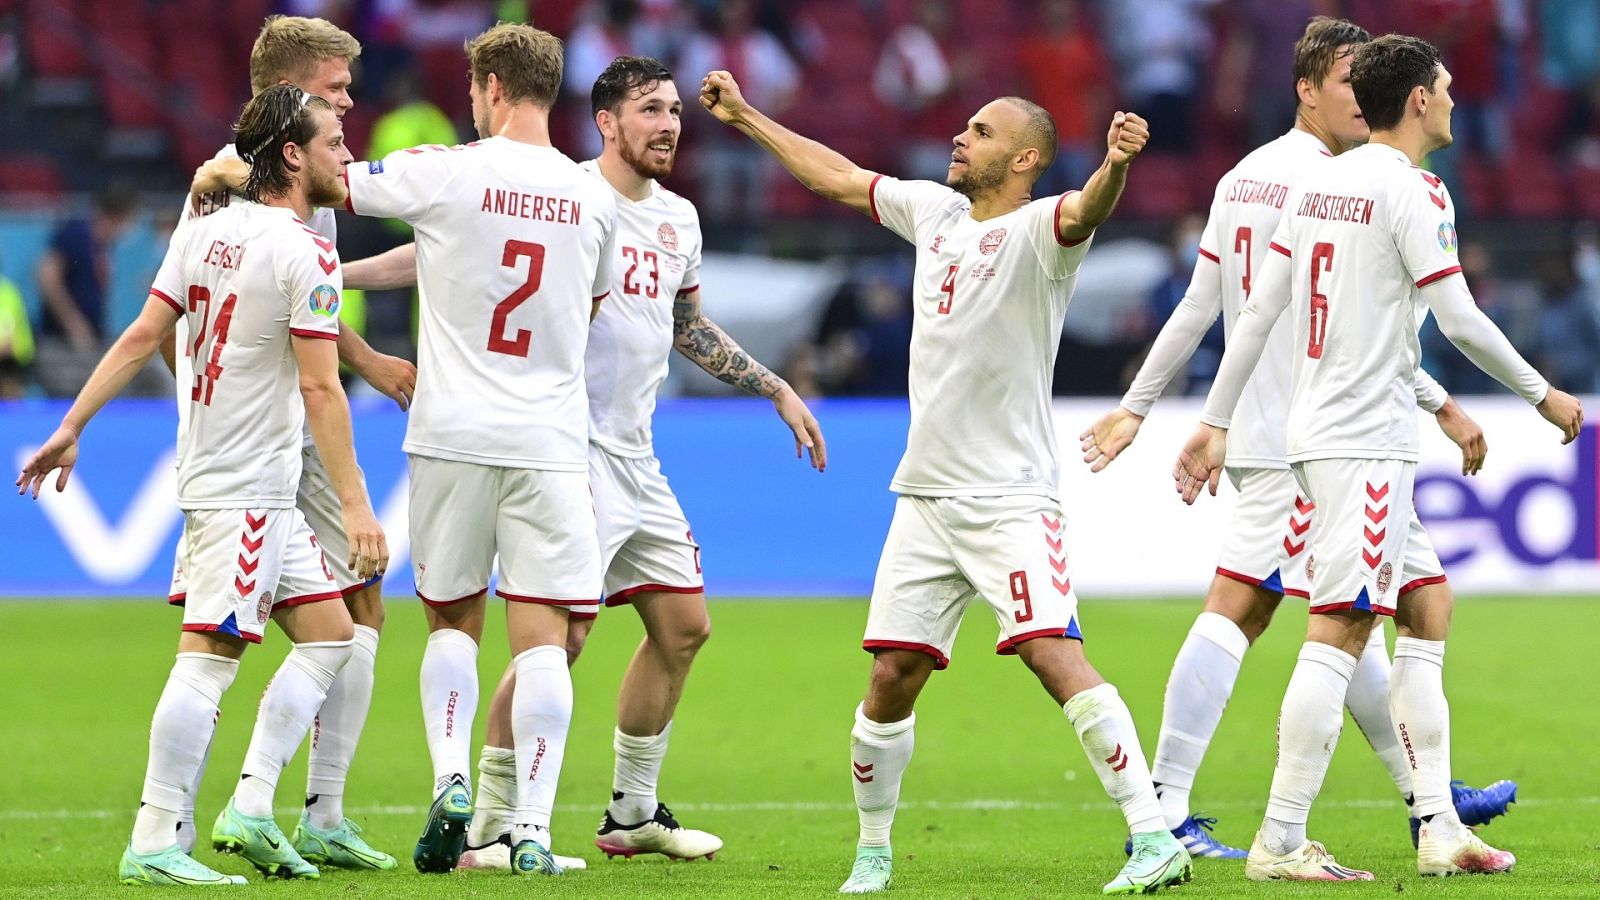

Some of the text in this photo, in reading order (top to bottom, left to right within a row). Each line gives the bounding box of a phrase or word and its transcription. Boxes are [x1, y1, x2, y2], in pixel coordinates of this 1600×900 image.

[481, 187, 581, 225] ANDERSEN
[1297, 192, 1375, 225] CHRISTENSEN
[621, 245, 660, 299] 23
[937, 265, 960, 315] 9
[486, 239, 546, 358] 2
[1307, 242, 1335, 360] 6
[1009, 570, 1034, 624] 9
[446, 691, 459, 738] DANMARK
[530, 737, 547, 781] DANMARK
[1398, 722, 1418, 771] DANMARK
